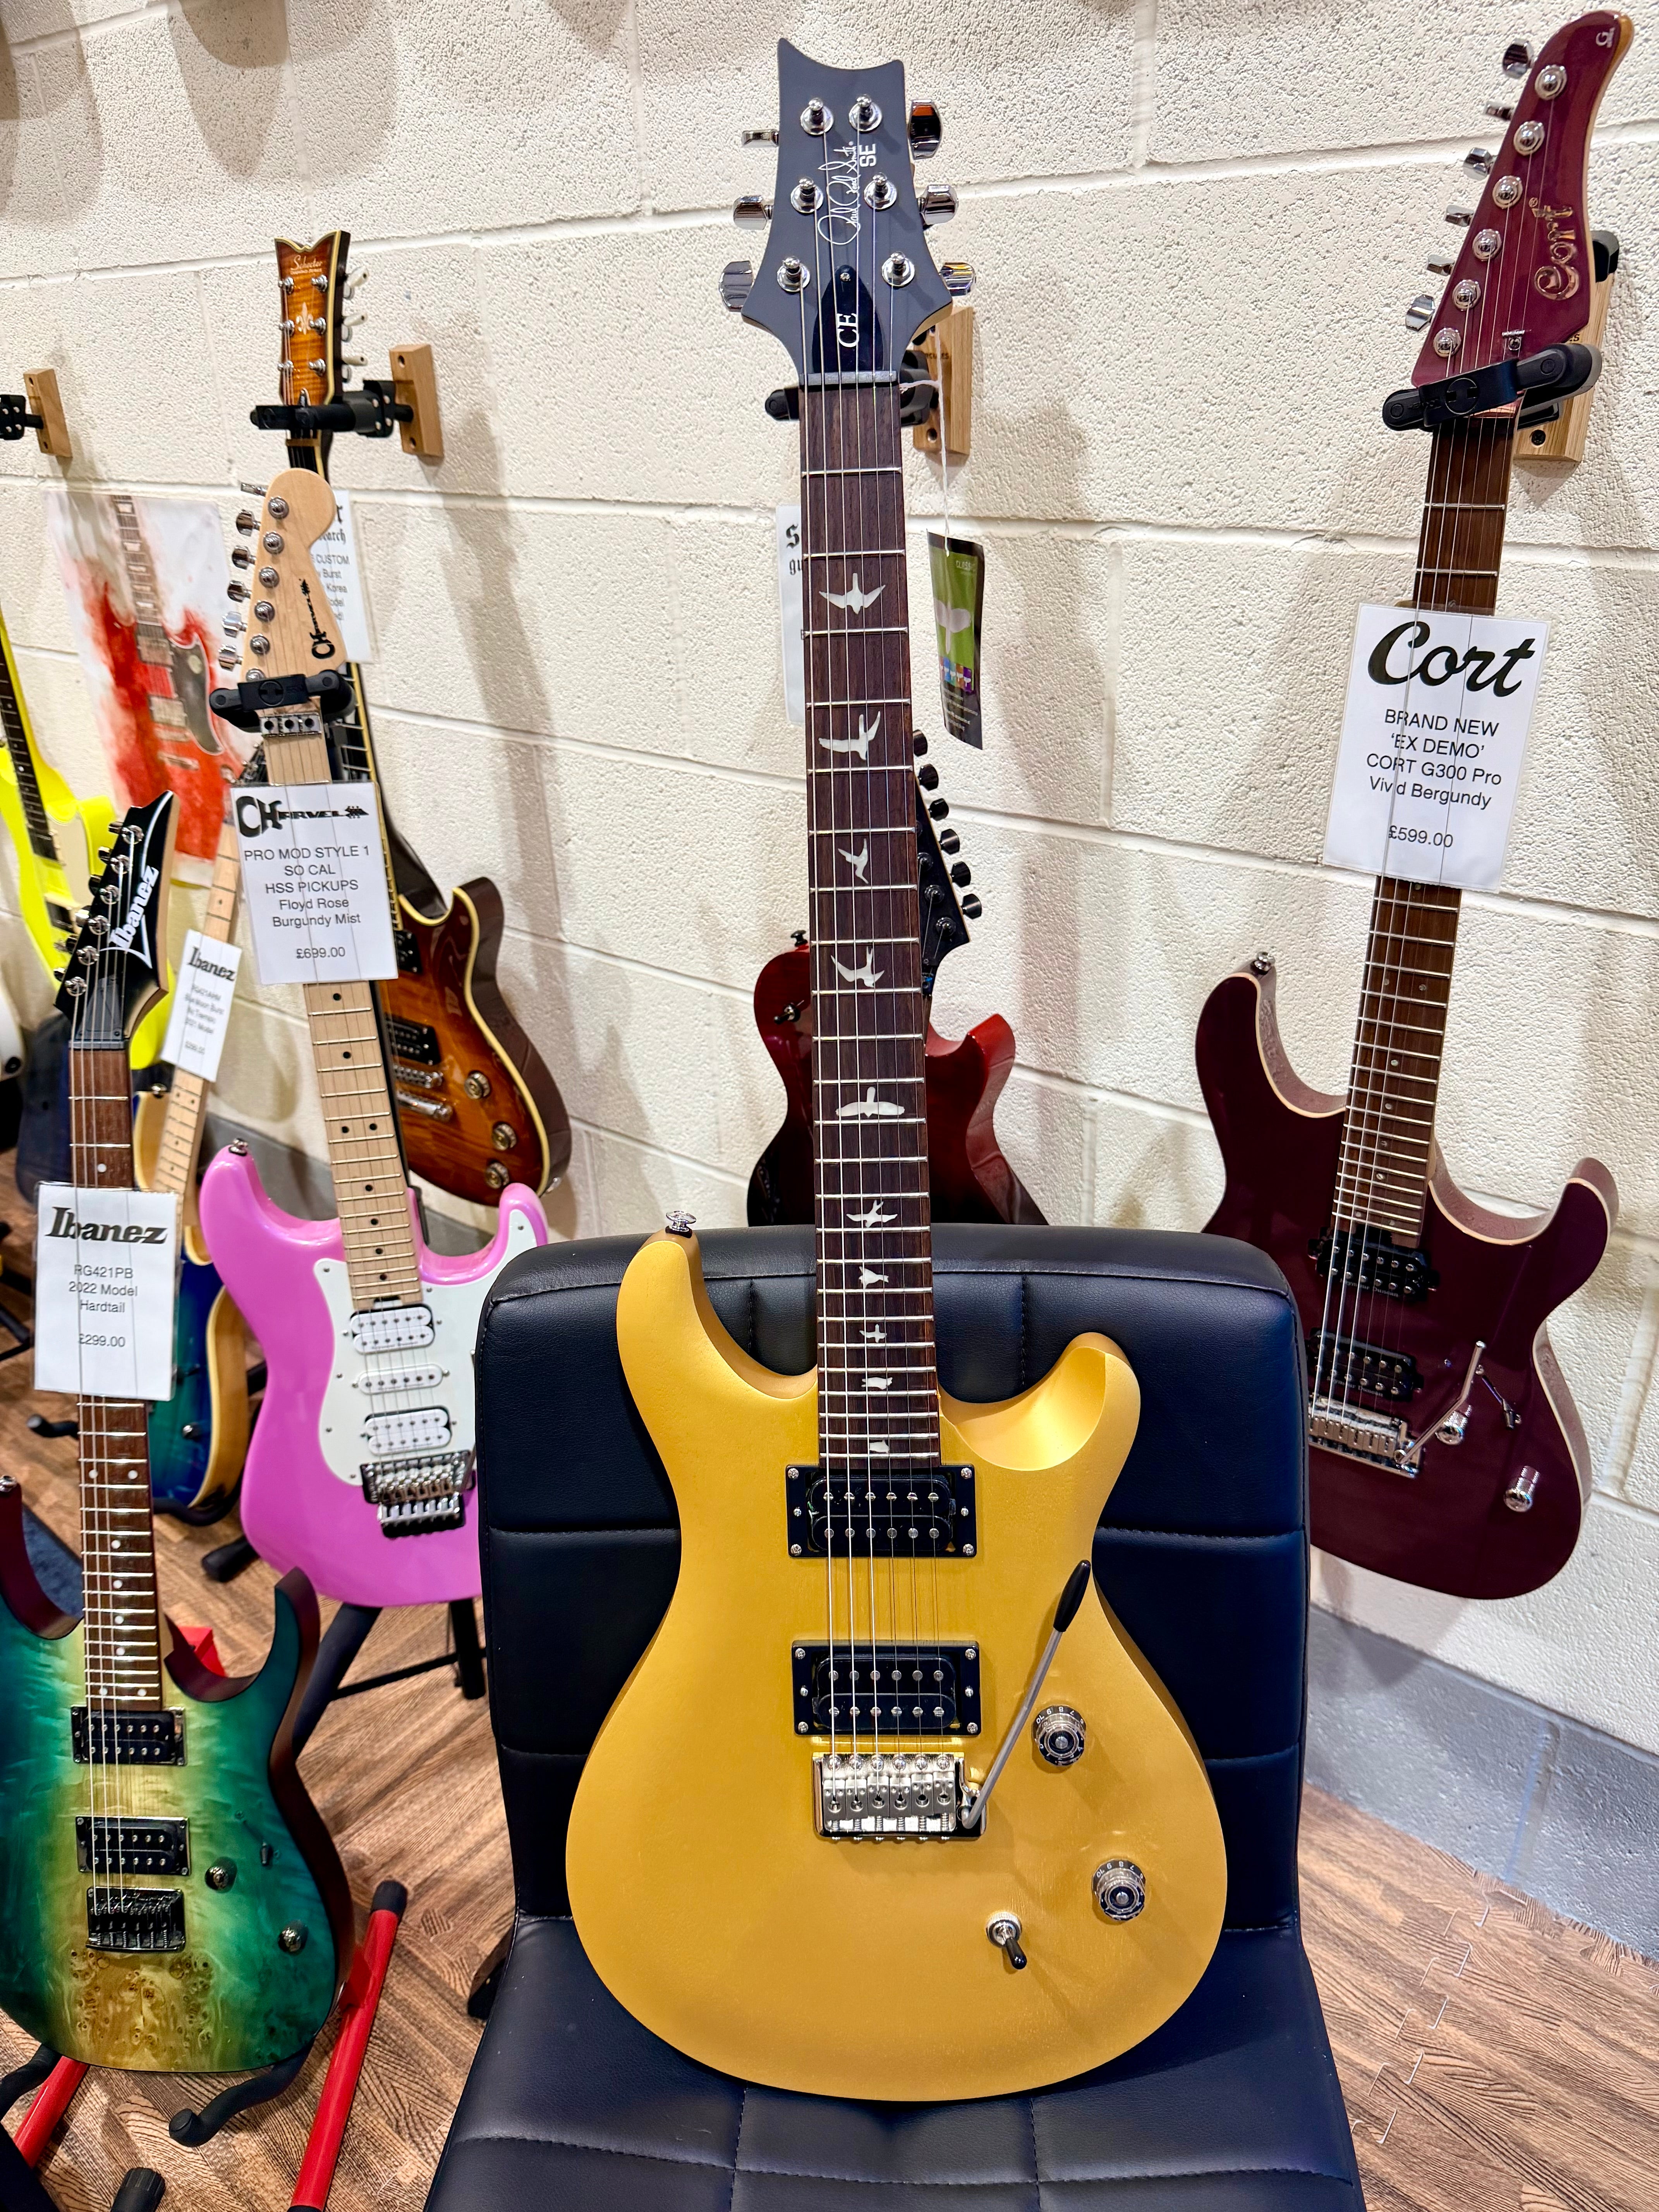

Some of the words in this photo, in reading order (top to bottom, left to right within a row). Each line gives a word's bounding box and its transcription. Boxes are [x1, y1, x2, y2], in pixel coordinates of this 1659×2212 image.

[859, 143, 877, 167] SE
[838, 313, 860, 348] CE
[316, 555, 350, 565] CUSTOM
[329, 598, 344, 607] odel
[1367, 621, 1535, 697] Cort
[1384, 709, 1448, 731] BRAND
[1454, 718, 1499, 737] NEW
[1367, 753, 1416, 774] CORT
[1421, 762, 1465, 781] G300
[1472, 768, 1501, 786] Pro
[1370, 776, 1407, 795] Vivd
[1411, 781, 1491, 809] Bergundy
[1388, 825, 1453, 848] £599.00
[244, 849, 275, 861] PRO
[279, 848, 311, 860] MOD
[316, 846, 358, 859] STYLE
[364, 845, 369, 856] 1
[284, 865, 304, 876] SO
[309, 864, 336, 875] CAL
[266, 883, 294, 893] HSS
[299, 880, 359, 892] PICKUPS
[108, 865, 159, 949] Ibanez
[280, 899, 313, 912] Floyd
[318, 898, 349, 908] Rose
[273, 915, 331, 928] Burgundy
[336, 914, 361, 924] Mist
[296, 947, 345, 958] £699.00
[188, 946, 235, 981] Ibanez
[45, 1206, 167, 1245] Ibanez
[74, 1264, 133, 1279] RG421PB
[69, 1281, 97, 1294] 2022
[101, 1284, 137, 1297] Model
[80, 1300, 125, 1313] Hardtail
[79, 1333, 125, 1347] £299.00
